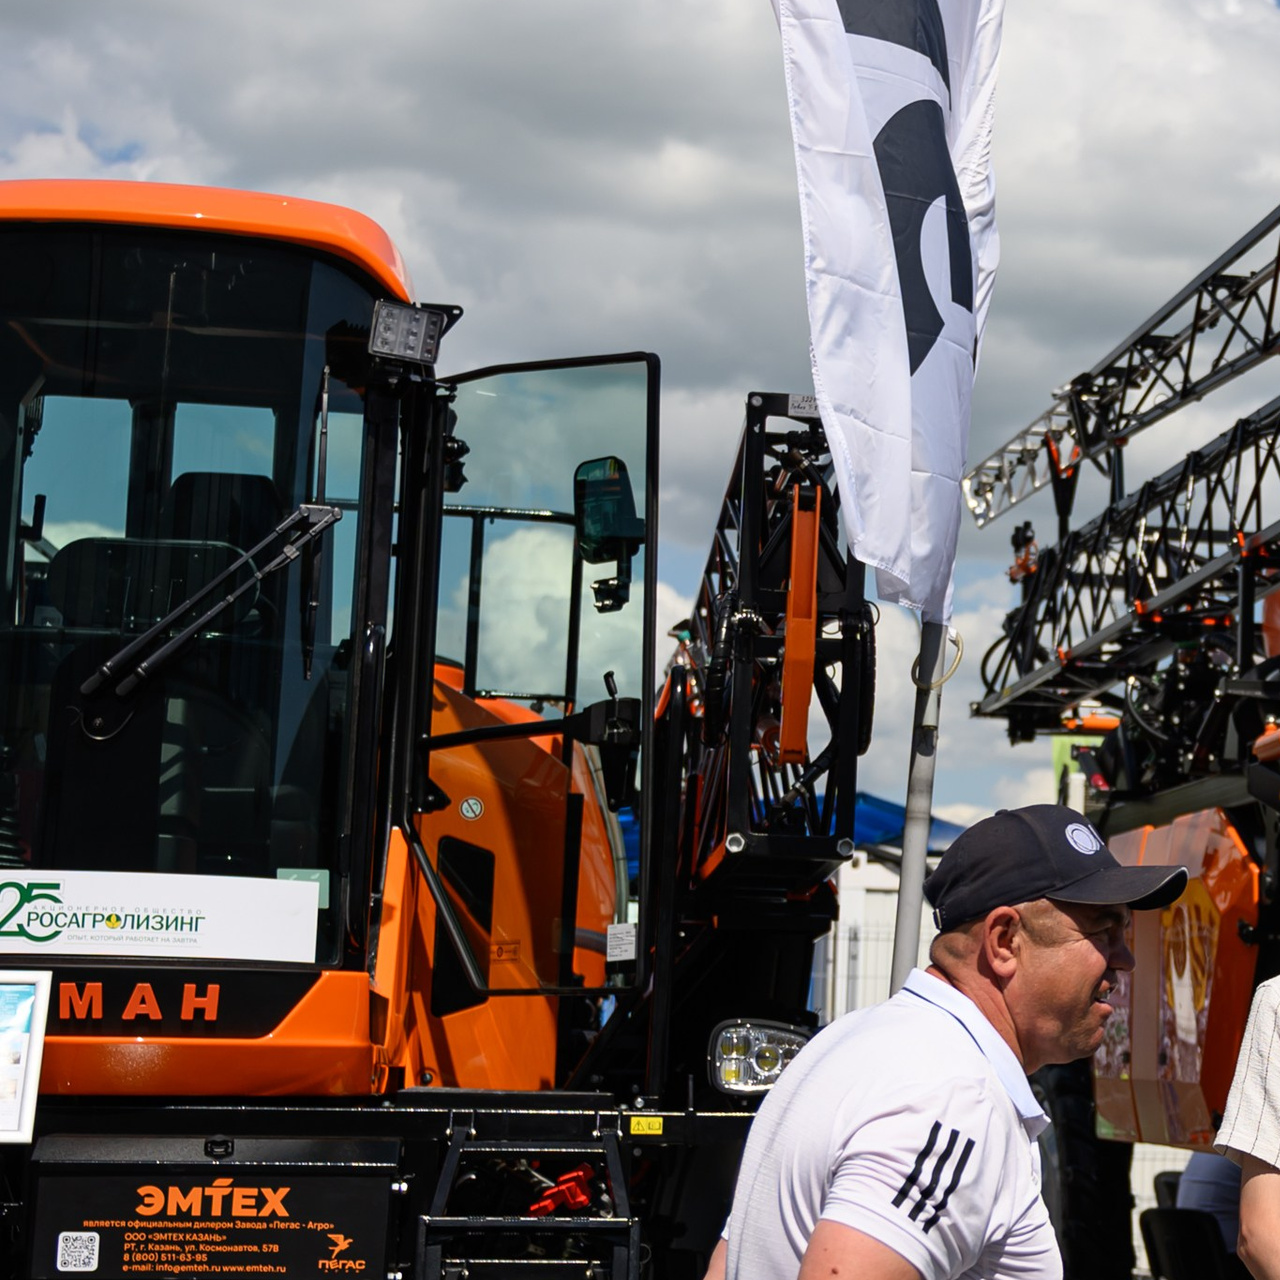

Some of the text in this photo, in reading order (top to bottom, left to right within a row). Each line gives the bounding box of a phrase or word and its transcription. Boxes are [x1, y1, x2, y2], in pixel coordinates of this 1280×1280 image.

[134, 906, 202, 915] ОБЩЕСТВО
[27, 911, 206, 932] РОСАГРОЛИЗИНГ
[59, 982, 220, 1021] МАН
[135, 1179, 291, 1217] ЭМТЕХ
[83, 1220, 126, 1228] является
[127, 1219, 192, 1230] официальным
[193, 1221, 233, 1231] дилером
[235, 1221, 267, 1230] Завода
[124, 1232, 227, 1242] ООО «ЭМТЕХ КАЗАНЬ»
[123, 1243, 139, 1252] РТ,
[148, 1243, 183, 1252] Казань,
[184, 1244, 198, 1253] ул.
[199, 1244, 260, 1253] Космонавтов,
[123, 1253, 208, 1262] 8 (800) 511-63-95
[122, 1263, 287, 1273] e-mail: info@emteh.ru www.emteh.ru
[318, 1259, 366, 1270] ПЕГАС
